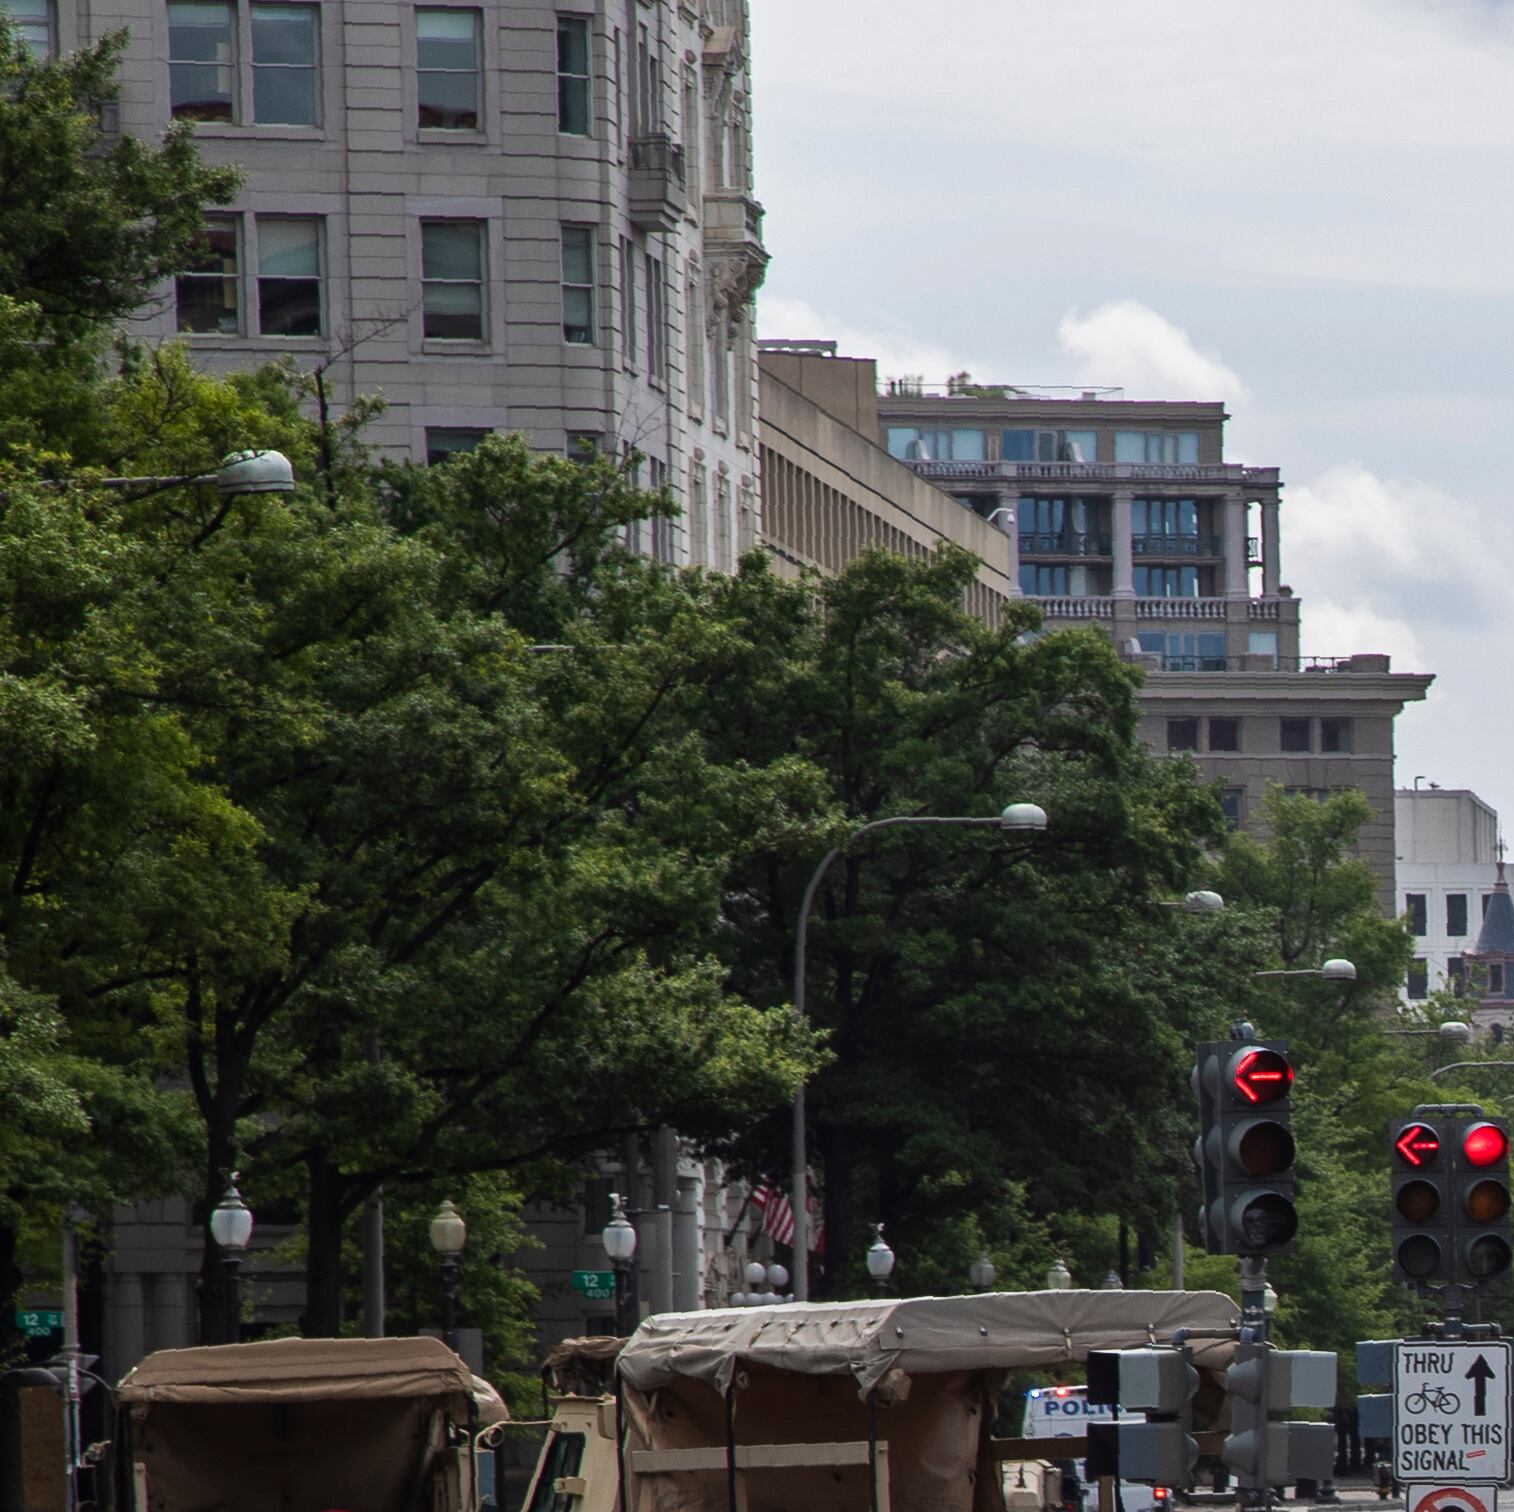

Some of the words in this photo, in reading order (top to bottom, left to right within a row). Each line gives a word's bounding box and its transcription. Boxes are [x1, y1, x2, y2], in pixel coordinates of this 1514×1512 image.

[582, 1273, 599, 1287] 12
[586, 1288, 610, 1298] 400
[23, 1313, 39, 1326] 12
[1403, 1352, 1454, 1374] THRU
[1401, 1423, 1453, 1445] OBEY
[1461, 1423, 1503, 1445] THIS
[1401, 1450, 1470, 1471] SIGNAL
